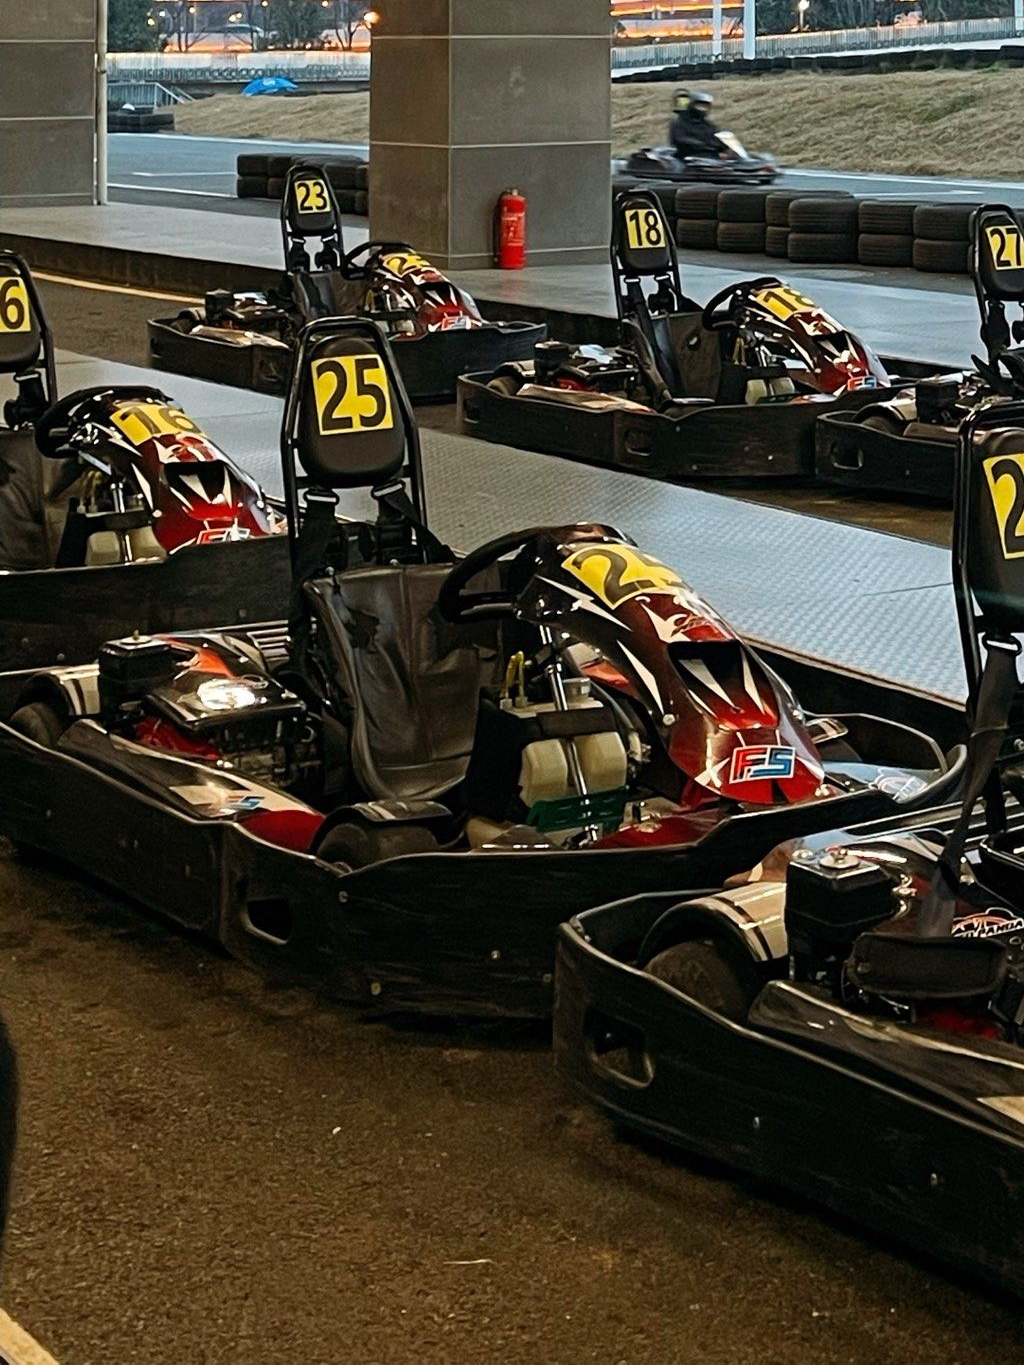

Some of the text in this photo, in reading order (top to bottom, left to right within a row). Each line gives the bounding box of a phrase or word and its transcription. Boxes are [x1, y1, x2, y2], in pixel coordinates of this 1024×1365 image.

[297, 181, 328, 211] 23
[629, 210, 662, 246] 18
[990, 228, 1022, 267] 27
[315, 358, 388, 431] 25
[731, 745, 797, 783] FS
